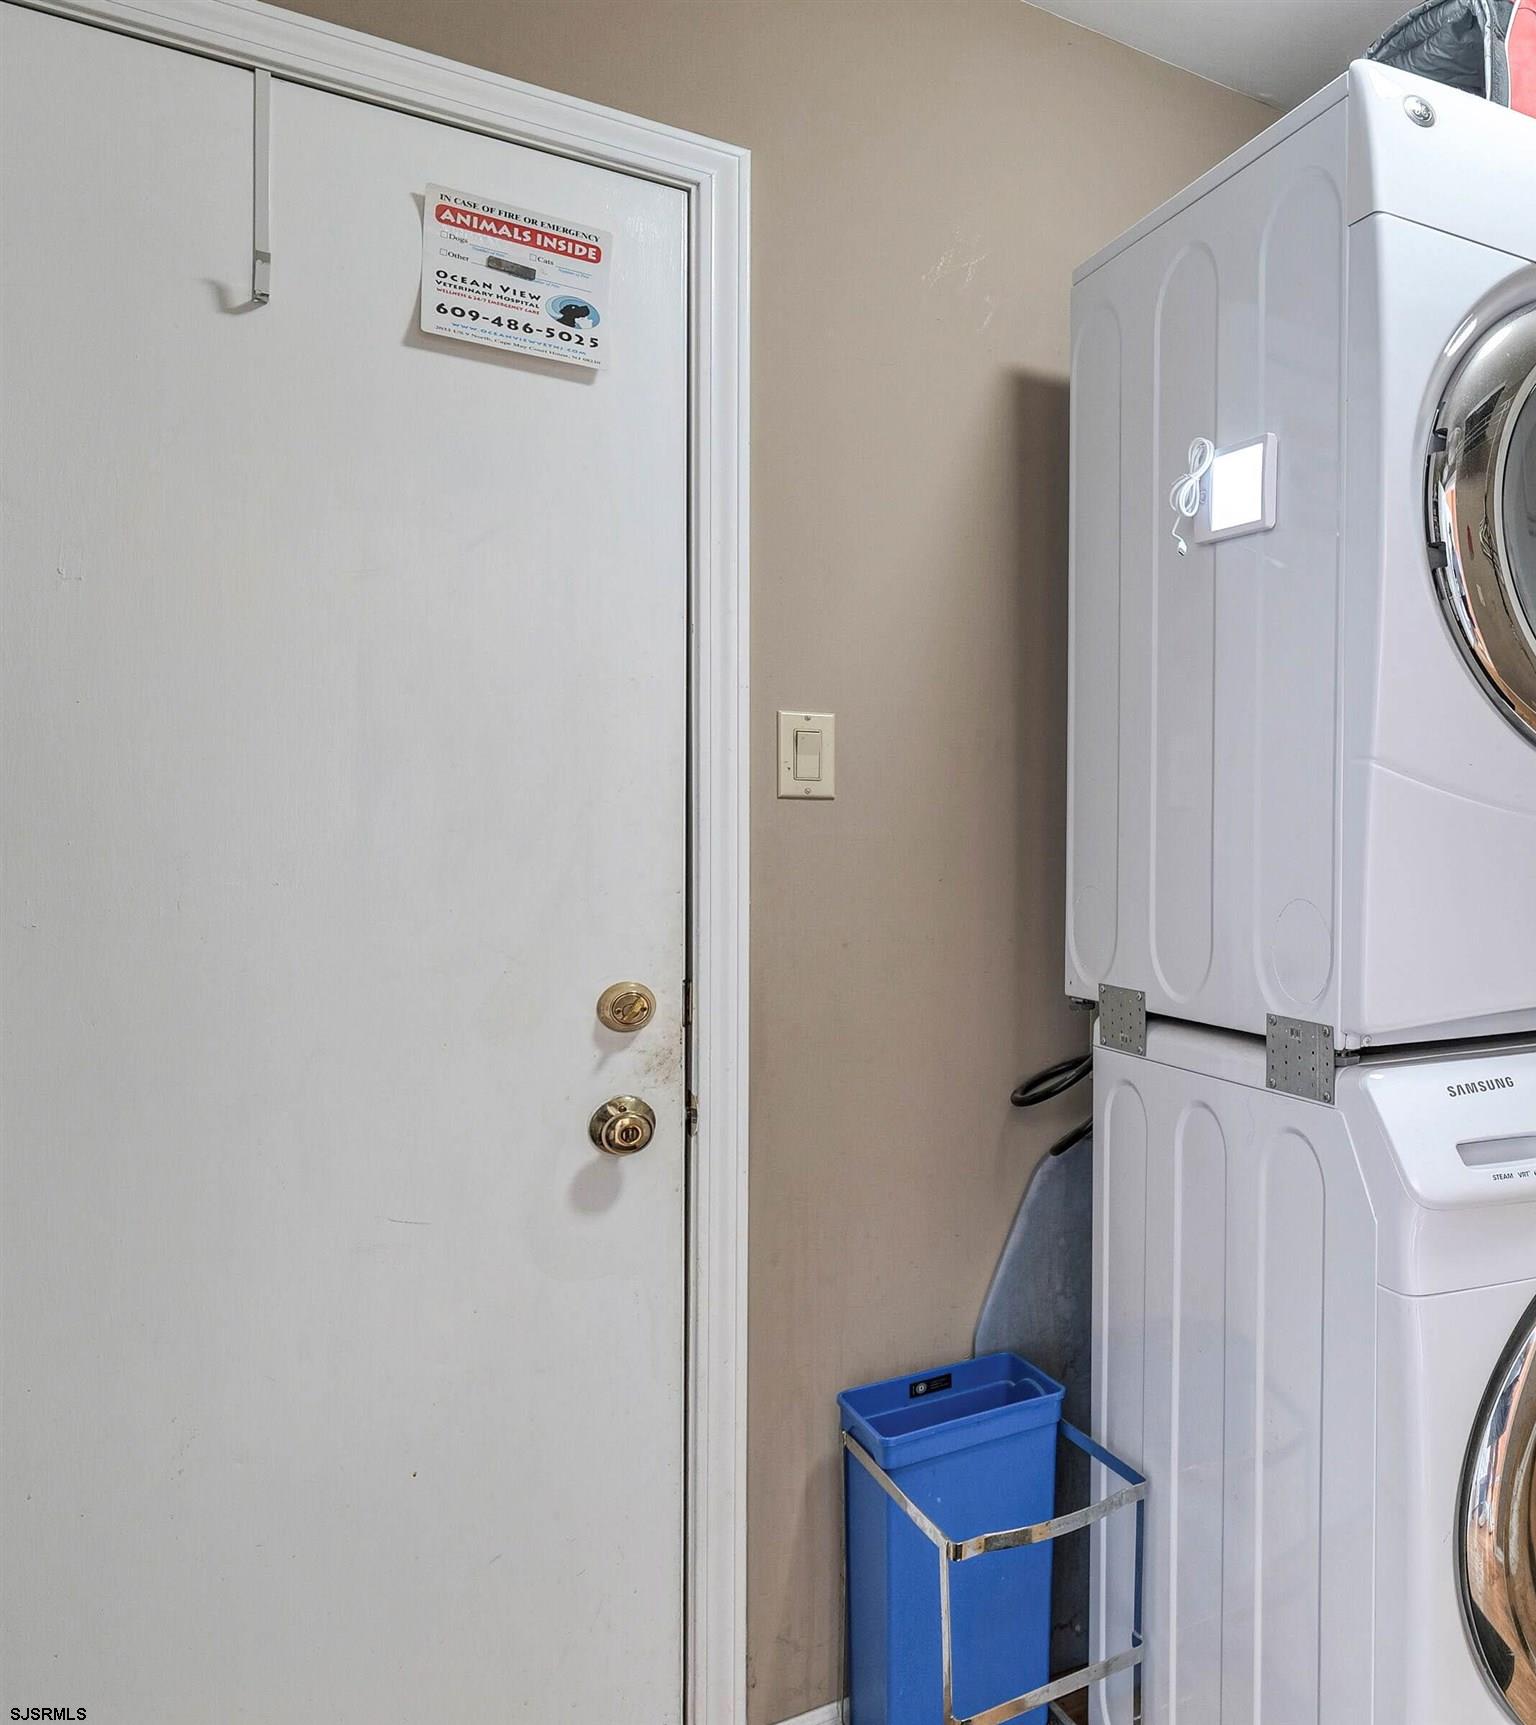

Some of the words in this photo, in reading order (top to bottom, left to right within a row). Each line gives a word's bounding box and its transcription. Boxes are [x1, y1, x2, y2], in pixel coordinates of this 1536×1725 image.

[440, 193, 451, 202] IN
[454, 197, 480, 210] CASE
[481, 204, 496, 214] OF
[498, 209, 521, 220] FIRE
[523, 216, 538, 226] OR
[540, 221, 600, 243] EMERGENCY
[440, 208, 531, 243] ANIMALS
[536, 233, 597, 260] INSIDE
[448, 233, 468, 245] Dogs
[447, 251, 469, 262] Other
[537, 256, 554, 266] Cats
[435, 279, 493, 298] VETERINARY
[496, 294, 540, 309] HOSPITAL
[436, 270, 493, 289] OCEAN
[500, 285, 541, 301] VIEW
[436, 303, 599, 348] 609-486-5025
[1447, 1076, 1515, 1097] SAMSUNG
[1492, 1172, 1513, 1181] STEAM
